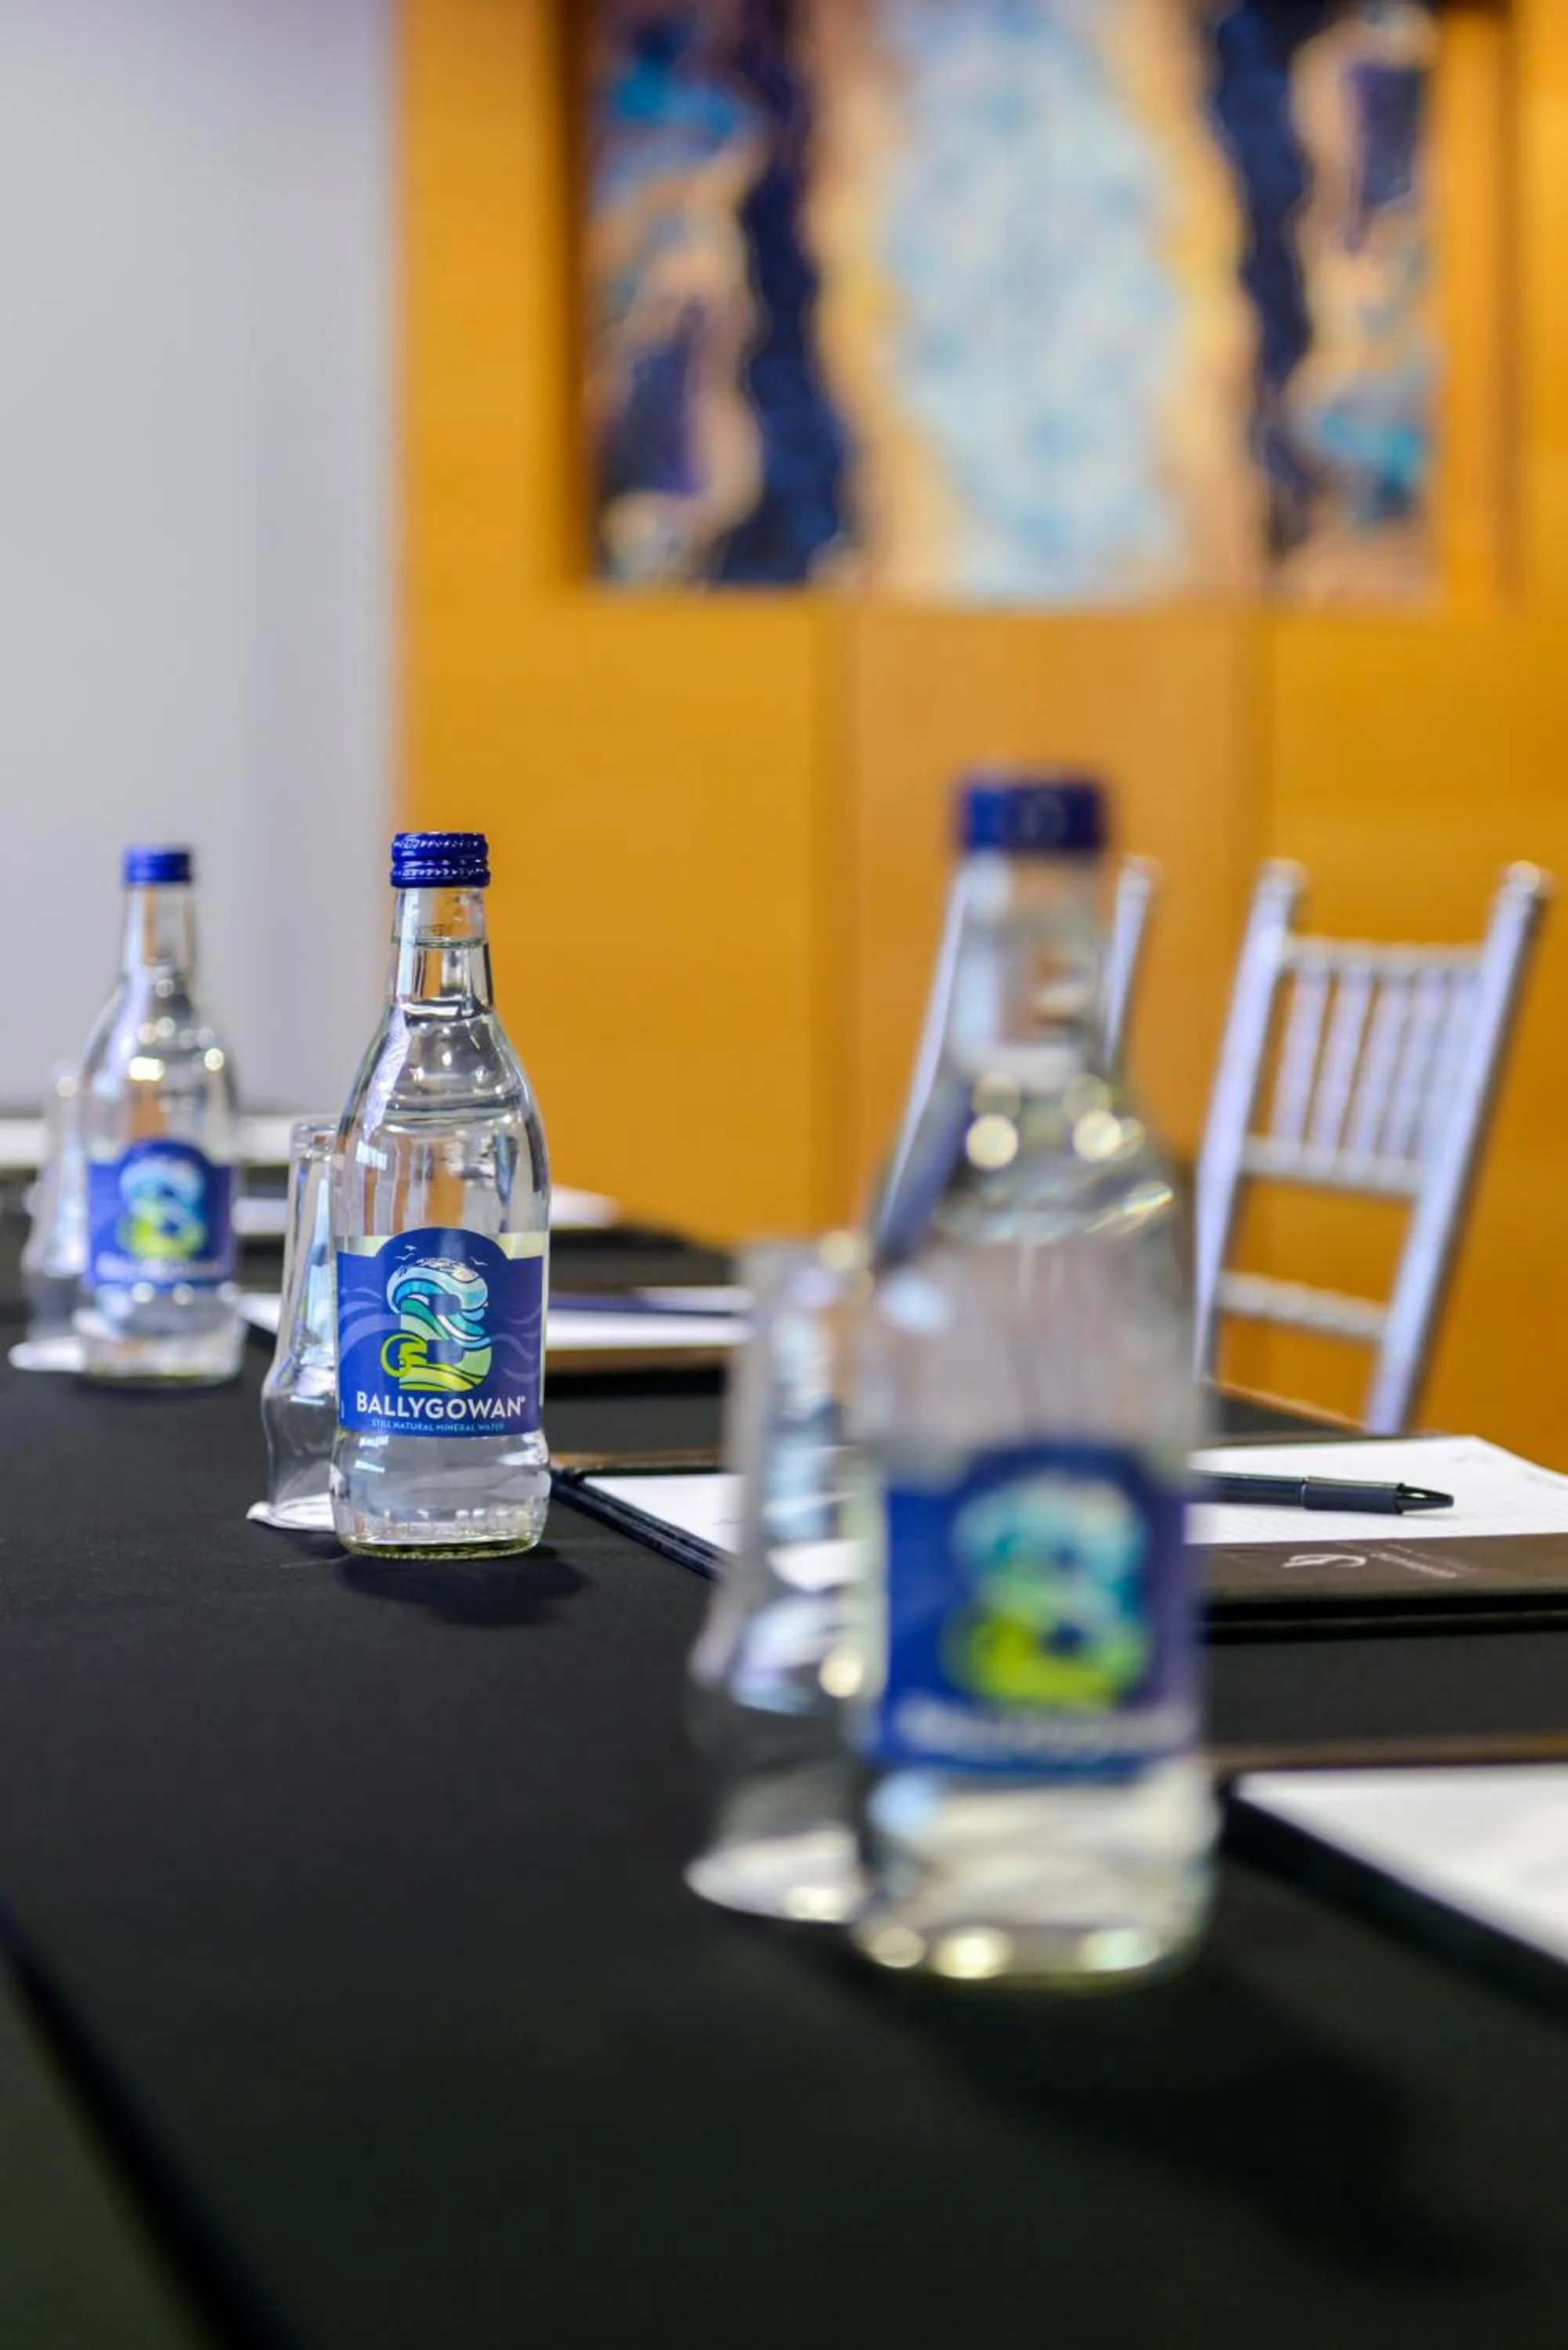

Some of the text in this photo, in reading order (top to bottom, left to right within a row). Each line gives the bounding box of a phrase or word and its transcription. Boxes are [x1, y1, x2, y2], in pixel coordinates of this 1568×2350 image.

[356, 1390, 522, 1419] BALLYGOWAN
[371, 1419, 505, 1433] STILL NATURAL MINERAL WATER
